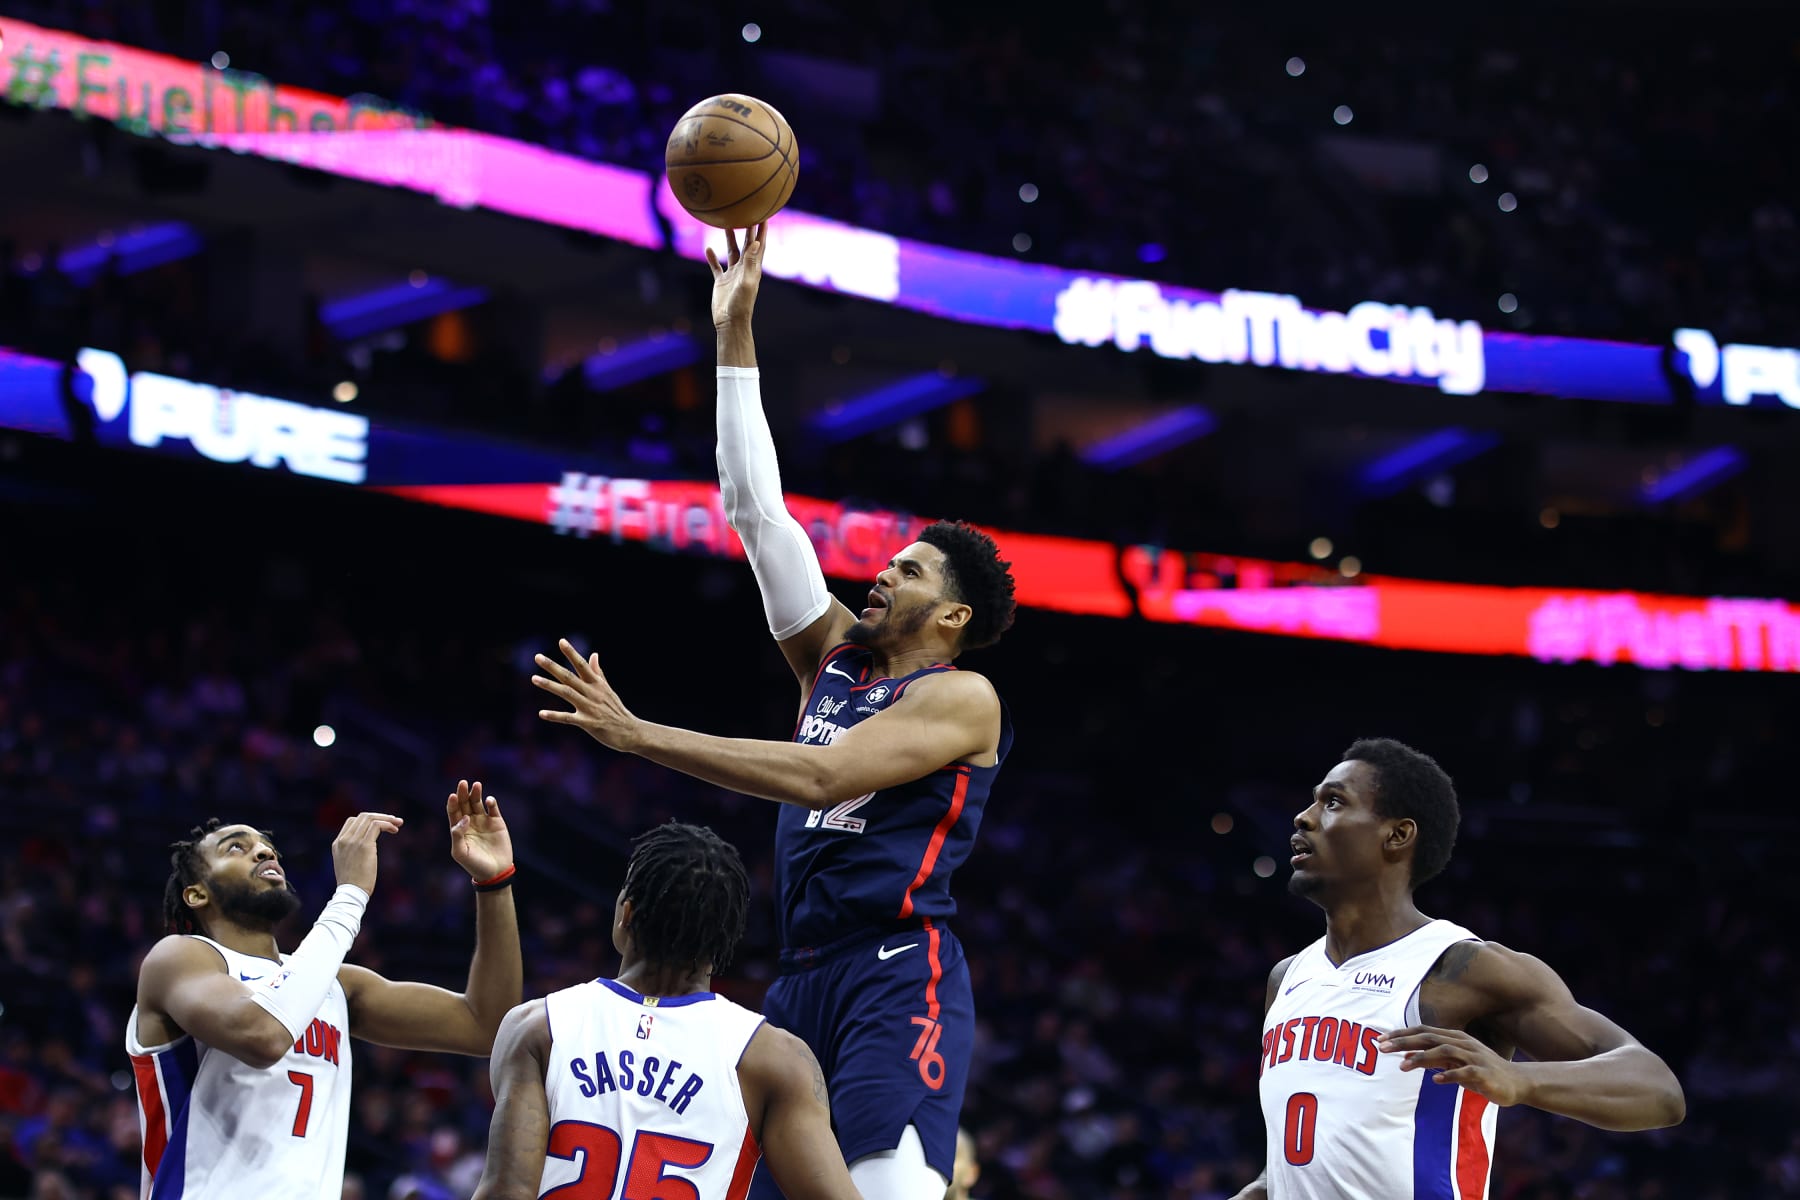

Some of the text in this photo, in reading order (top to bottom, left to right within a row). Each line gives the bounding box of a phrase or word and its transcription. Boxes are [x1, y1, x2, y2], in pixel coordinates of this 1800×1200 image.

[1054, 277, 1485, 395] #FuelTheCity
[129, 371, 369, 484] PURE
[799, 715, 848, 745] ROTH
[814, 696, 836, 719] City
[832, 700, 848, 716] of
[1354, 972, 1395, 989] UWM
[909, 1016, 945, 1091] 76
[1260, 1016, 1383, 1077] PISTONS
[287, 1069, 314, 1138] 7
[570, 1050, 704, 1116] SASSER
[538, 1119, 714, 1200] 25
[1284, 1092, 1319, 1167] 0
